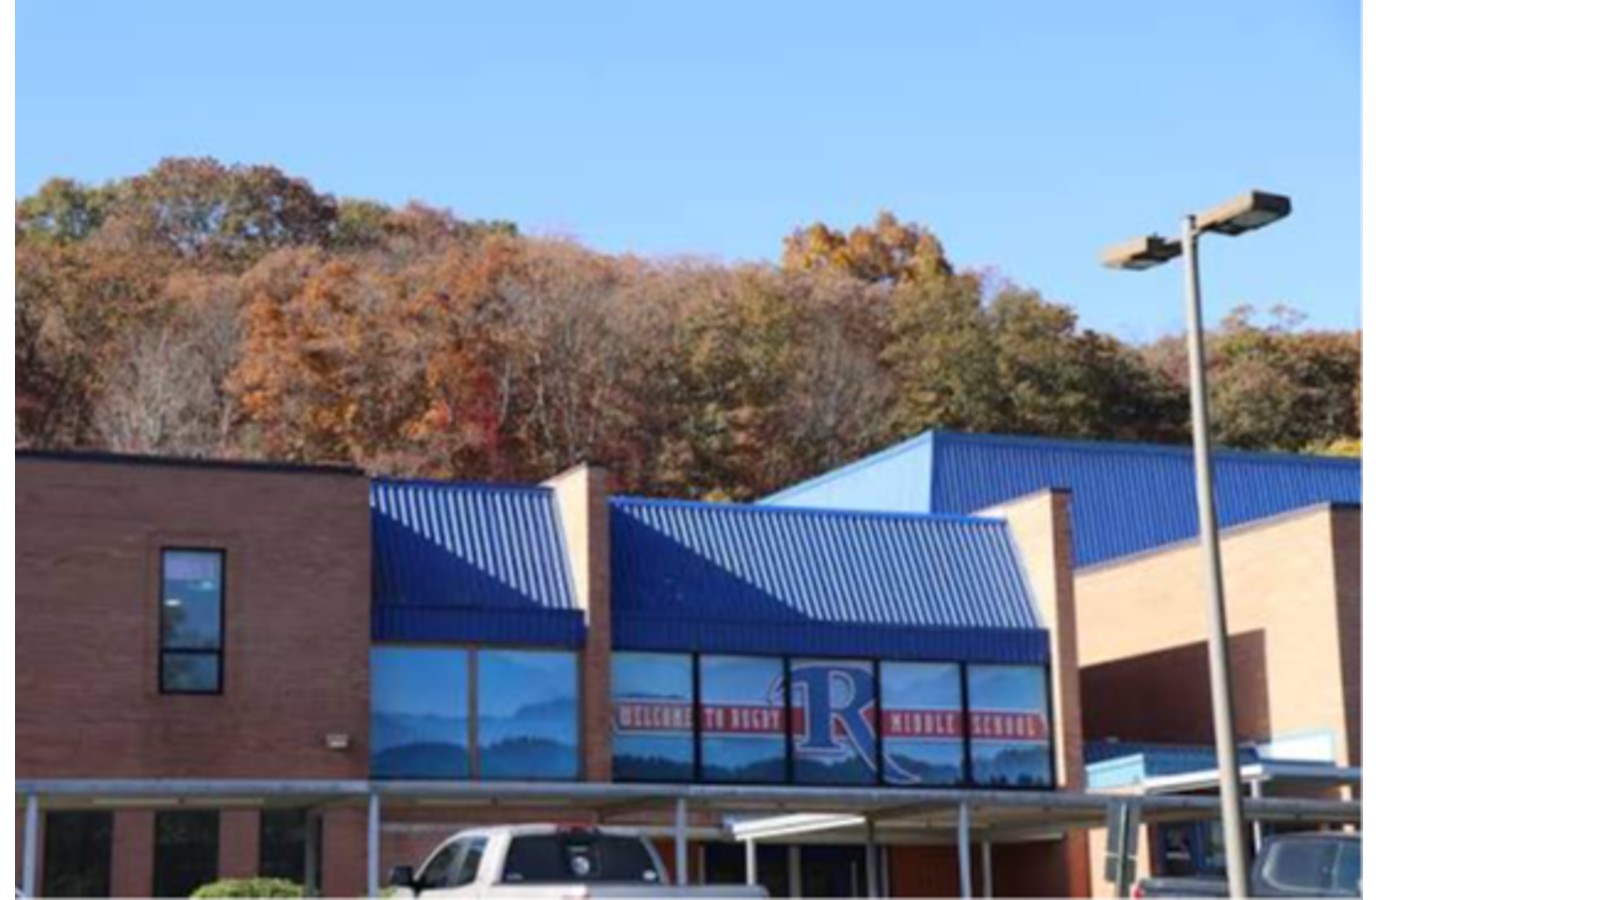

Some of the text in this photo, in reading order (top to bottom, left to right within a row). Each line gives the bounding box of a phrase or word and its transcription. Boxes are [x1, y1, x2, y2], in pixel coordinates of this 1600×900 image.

[620, 705, 1036, 735] WELCOME TO RUGBY MIDDLE SCHOOL
